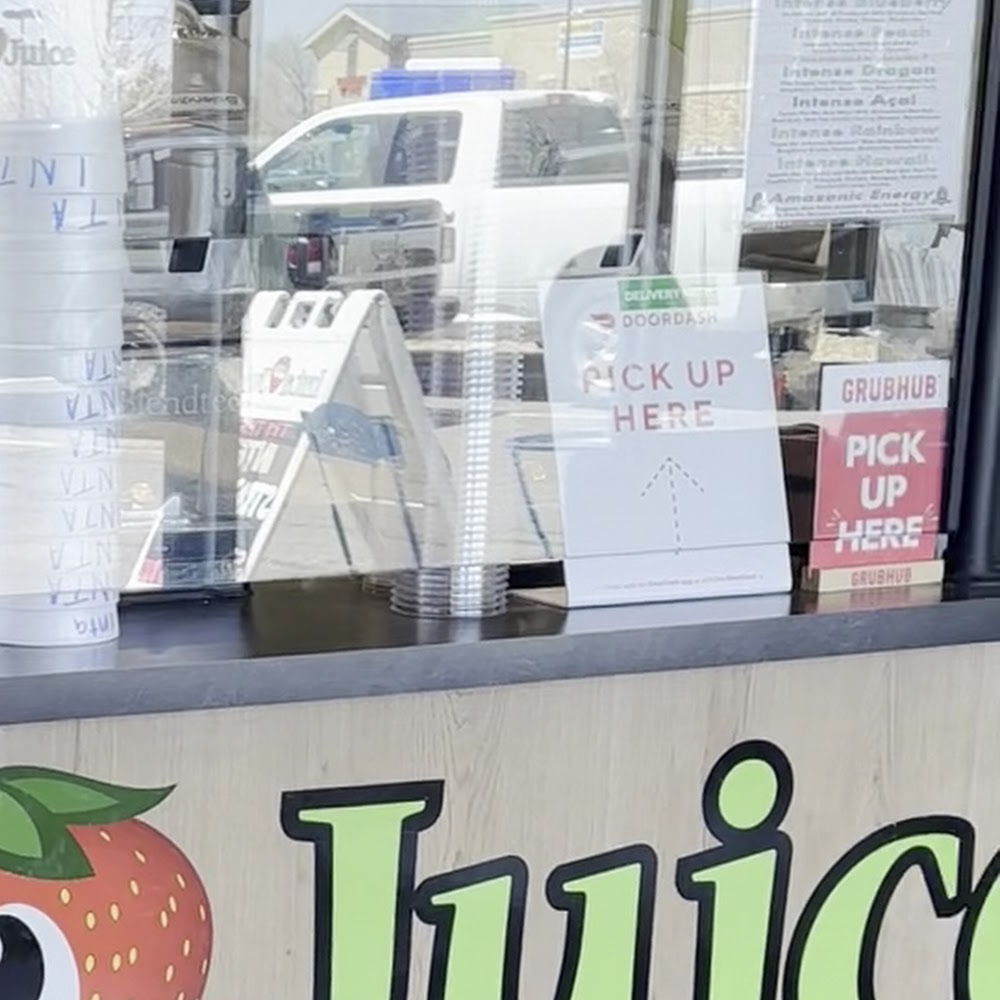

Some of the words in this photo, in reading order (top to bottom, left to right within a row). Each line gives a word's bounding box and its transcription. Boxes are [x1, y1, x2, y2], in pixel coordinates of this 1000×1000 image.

[4, 38, 77, 66] Juice
[782, 66, 854, 78] Intense
[861, 64, 936, 78] Dragon
[792, 96, 864, 108] Intense
[771, 127, 844, 139] Intense
[777, 157, 849, 170] Intense
[869, 188, 934, 204] Energy
[622, 311, 718, 328] DOORDASH
[583, 362, 673, 394] PICK
[687, 359, 735, 388] UP
[842, 374, 937, 403] GRUBHUB
[613, 399, 715, 432] HERE
[846, 430, 926, 468] PICK
[860, 475, 908, 510] UP
[835, 515, 924, 553] HERE
[851, 567, 913, 587] GRUBHUB
